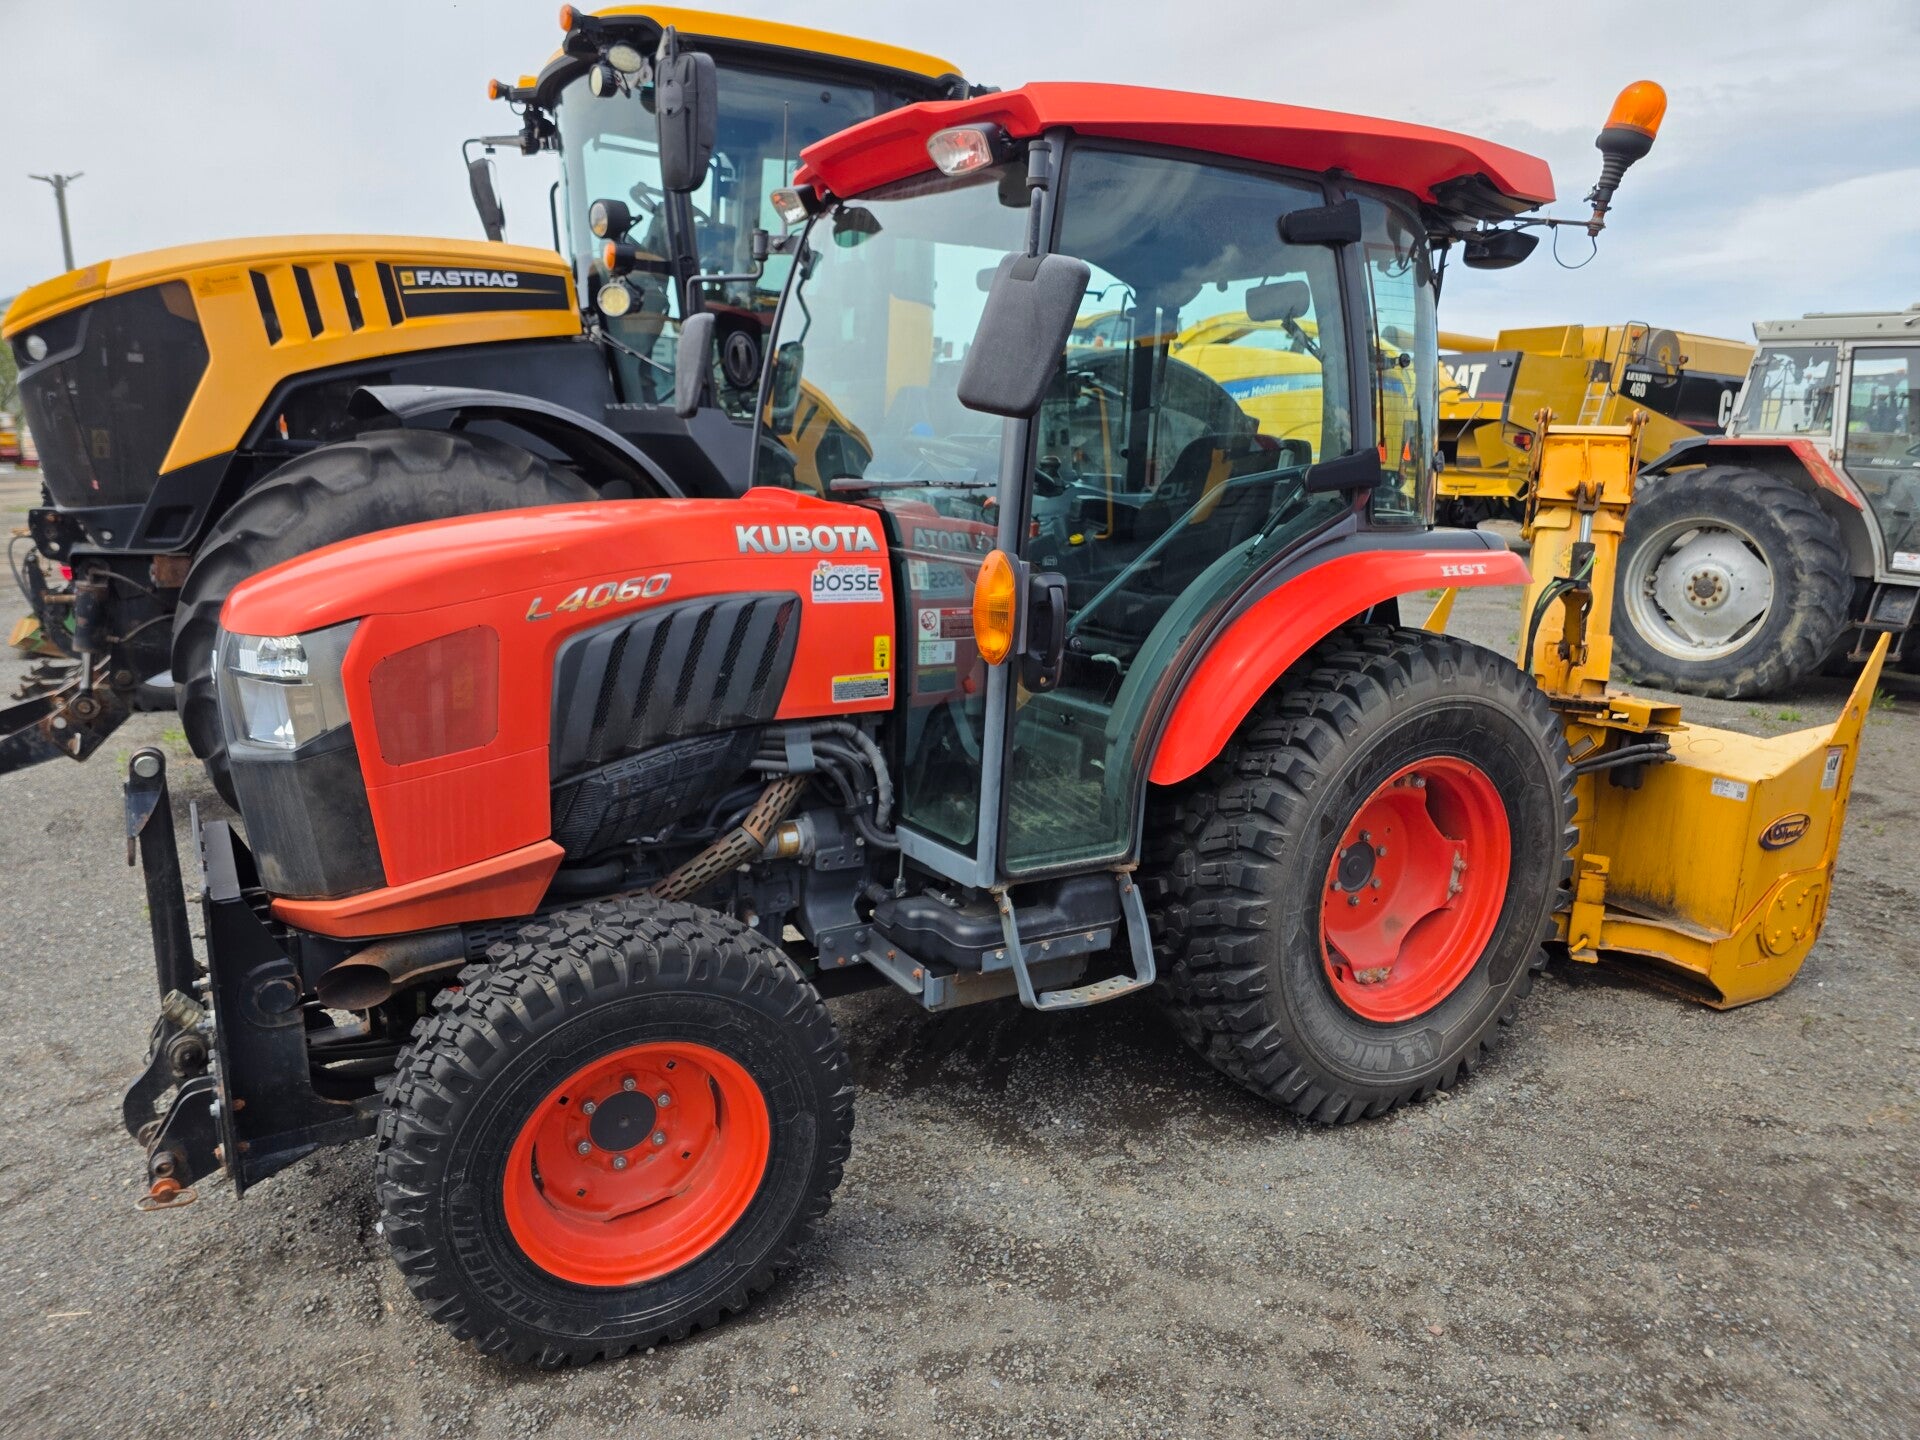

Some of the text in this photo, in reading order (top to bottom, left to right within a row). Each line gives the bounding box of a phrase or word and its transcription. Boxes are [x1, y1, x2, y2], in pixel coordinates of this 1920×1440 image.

[415, 270, 519, 288] FASTRAC
[1251, 381, 1289, 397] Holland
[1446, 364, 1487, 399] AT
[1630, 382, 1647, 397] 460
[735, 525, 880, 553] KUBOTA
[1441, 563, 1487, 577] HST
[813, 574, 880, 592] BOSSE
[525, 572, 672, 622] L 4060
[451, 1203, 549, 1321] MICHELIN
